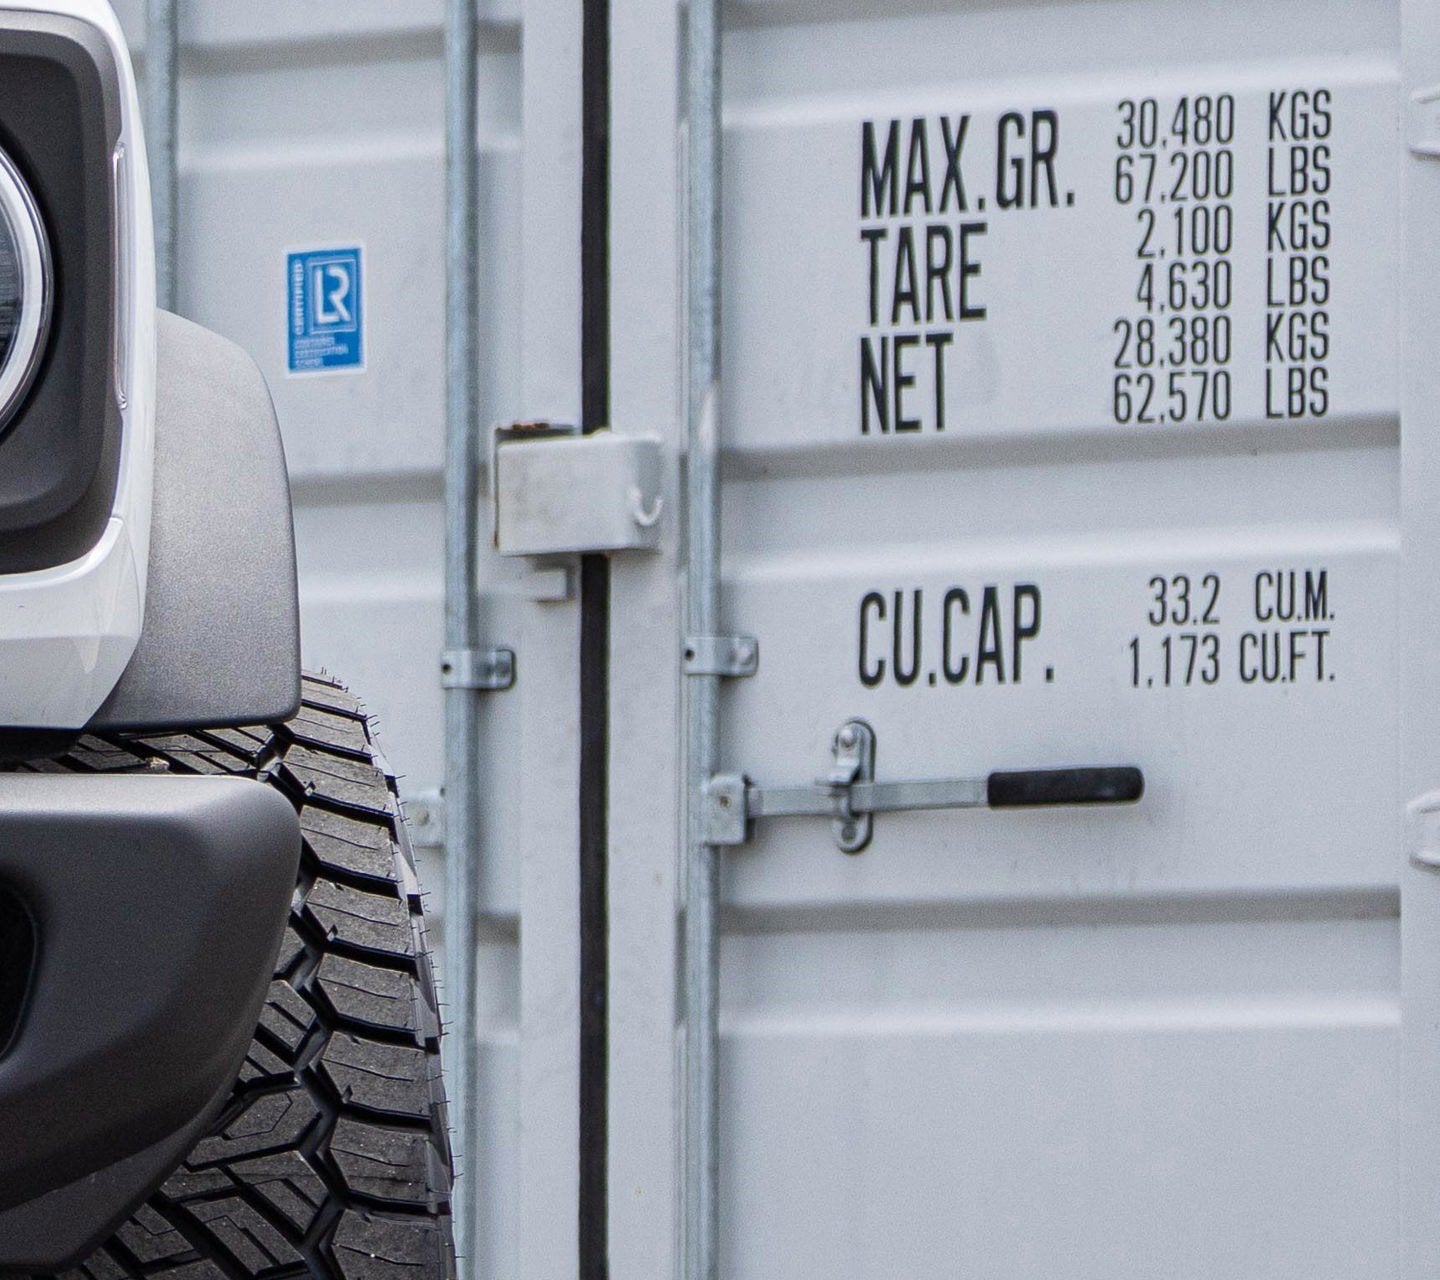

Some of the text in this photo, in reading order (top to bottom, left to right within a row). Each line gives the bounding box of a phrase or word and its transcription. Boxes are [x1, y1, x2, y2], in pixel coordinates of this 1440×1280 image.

[861, 110, 1075, 217] MAX.GR.
[1268, 89, 1332, 142] KGS
[1268, 145, 1331, 197] LBS
[860, 222, 988, 327] TARE
[1267, 200, 1331, 252] KGS
[1266, 255, 1330, 307] LBS
[860, 332, 953, 435] NET
[1266, 311, 1330, 363] KGS
[1265, 366, 1329, 419] LBS
[858, 570, 1336, 689] CU.CAP. 33.2 CU.M.
[1239, 630, 1336, 684] CU.FT.
